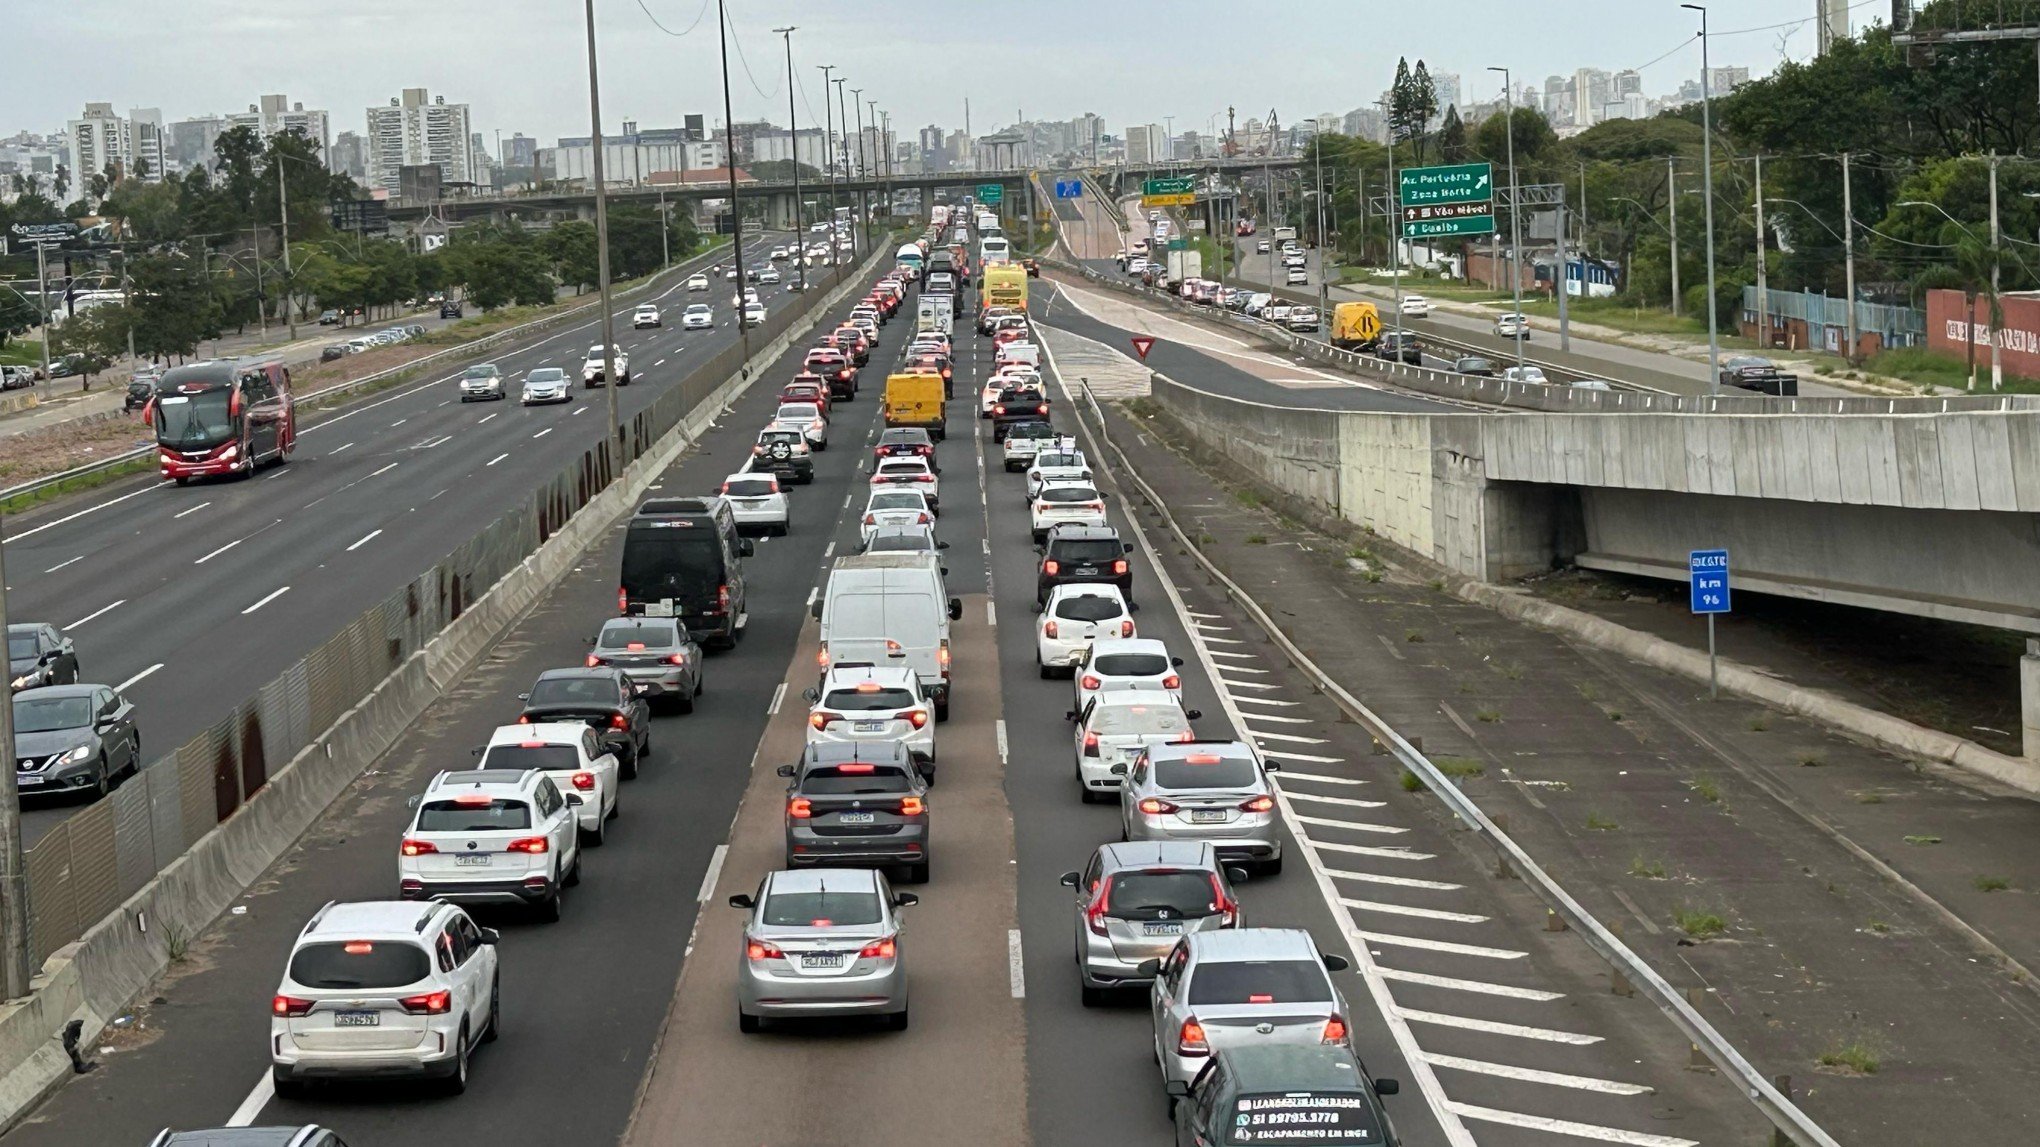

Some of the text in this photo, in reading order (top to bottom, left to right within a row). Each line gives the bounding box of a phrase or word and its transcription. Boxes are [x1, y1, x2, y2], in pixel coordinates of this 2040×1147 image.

[1699, 577, 1721, 589] km
[1702, 594, 1720, 605] 96
[1252, 1114, 1265, 1125] 51
